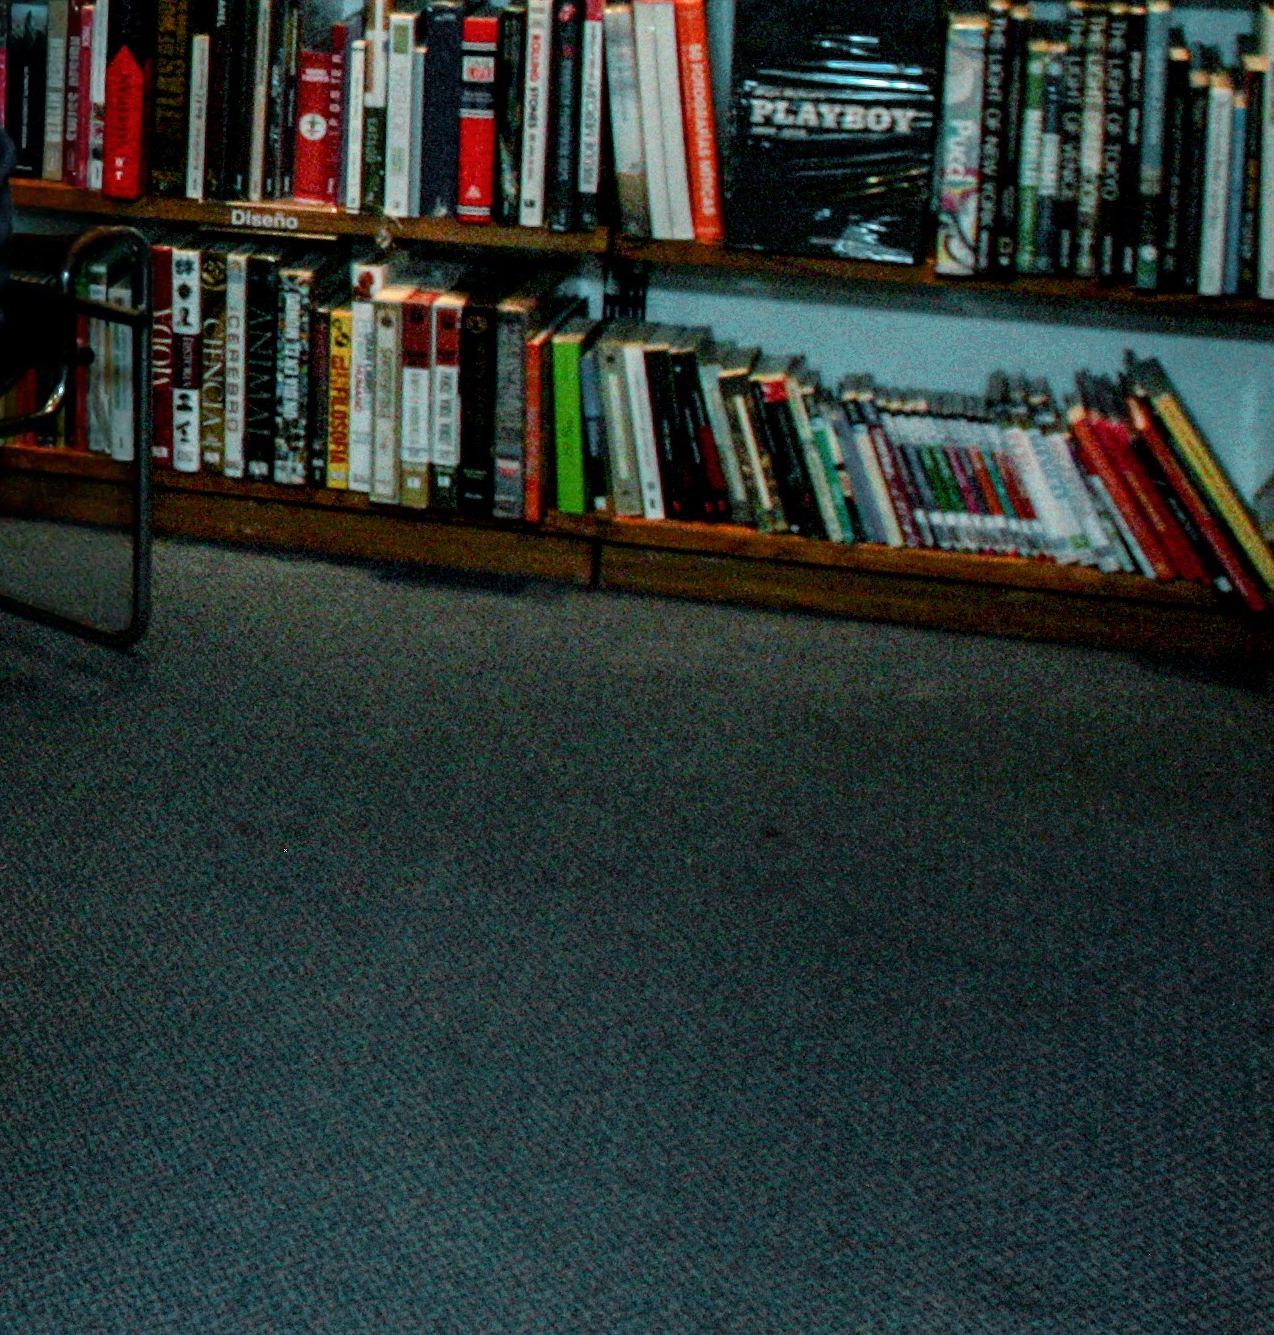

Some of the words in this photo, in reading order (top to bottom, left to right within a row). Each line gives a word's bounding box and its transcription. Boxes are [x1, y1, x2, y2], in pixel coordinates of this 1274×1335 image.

[528, 33, 541, 82] ROLLING
[750, 97, 919, 134] PLAYBOY
[231, 209, 299, 230] Diseño
[202, 317, 225, 427] CIENCIA
